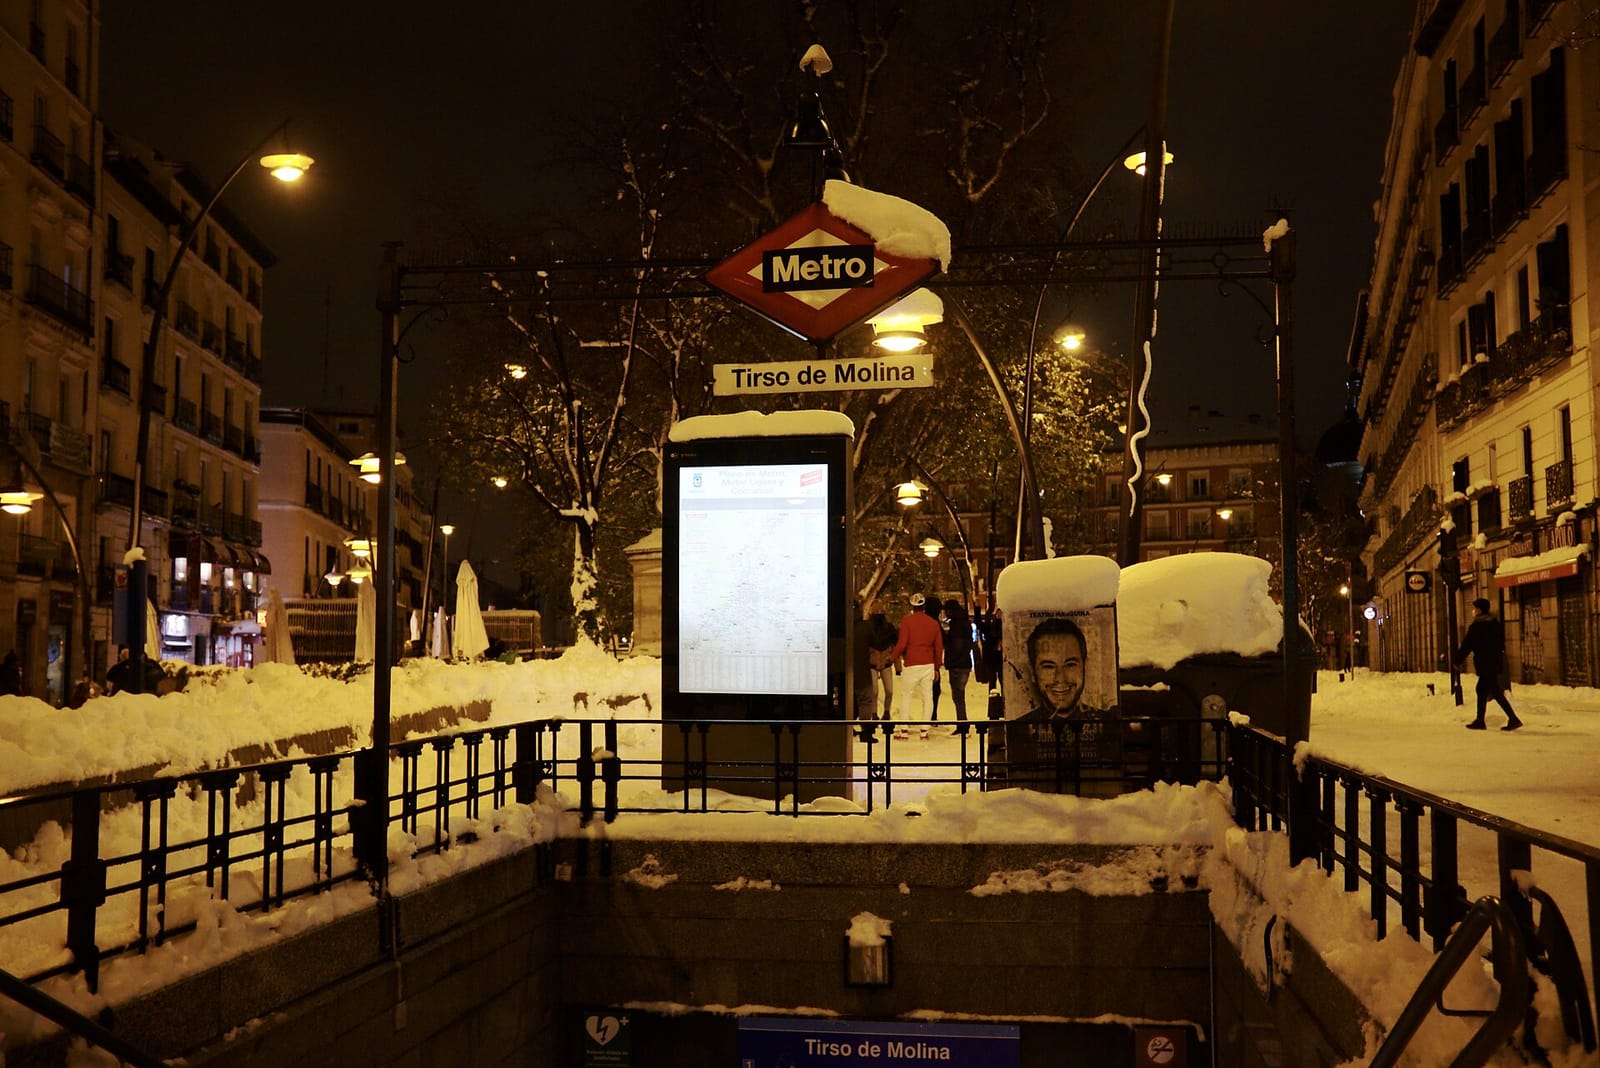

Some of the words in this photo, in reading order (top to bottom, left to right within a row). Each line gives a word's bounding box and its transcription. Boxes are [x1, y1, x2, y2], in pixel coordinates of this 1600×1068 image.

[772, 254, 866, 283] Metro
[731, 368, 790, 388] Tirso
[797, 365, 827, 386] de
[834, 362, 915, 384] Molina
[805, 1038, 852, 1058] Tirso
[858, 1041, 881, 1058] de
[887, 1042, 950, 1060] Molina
